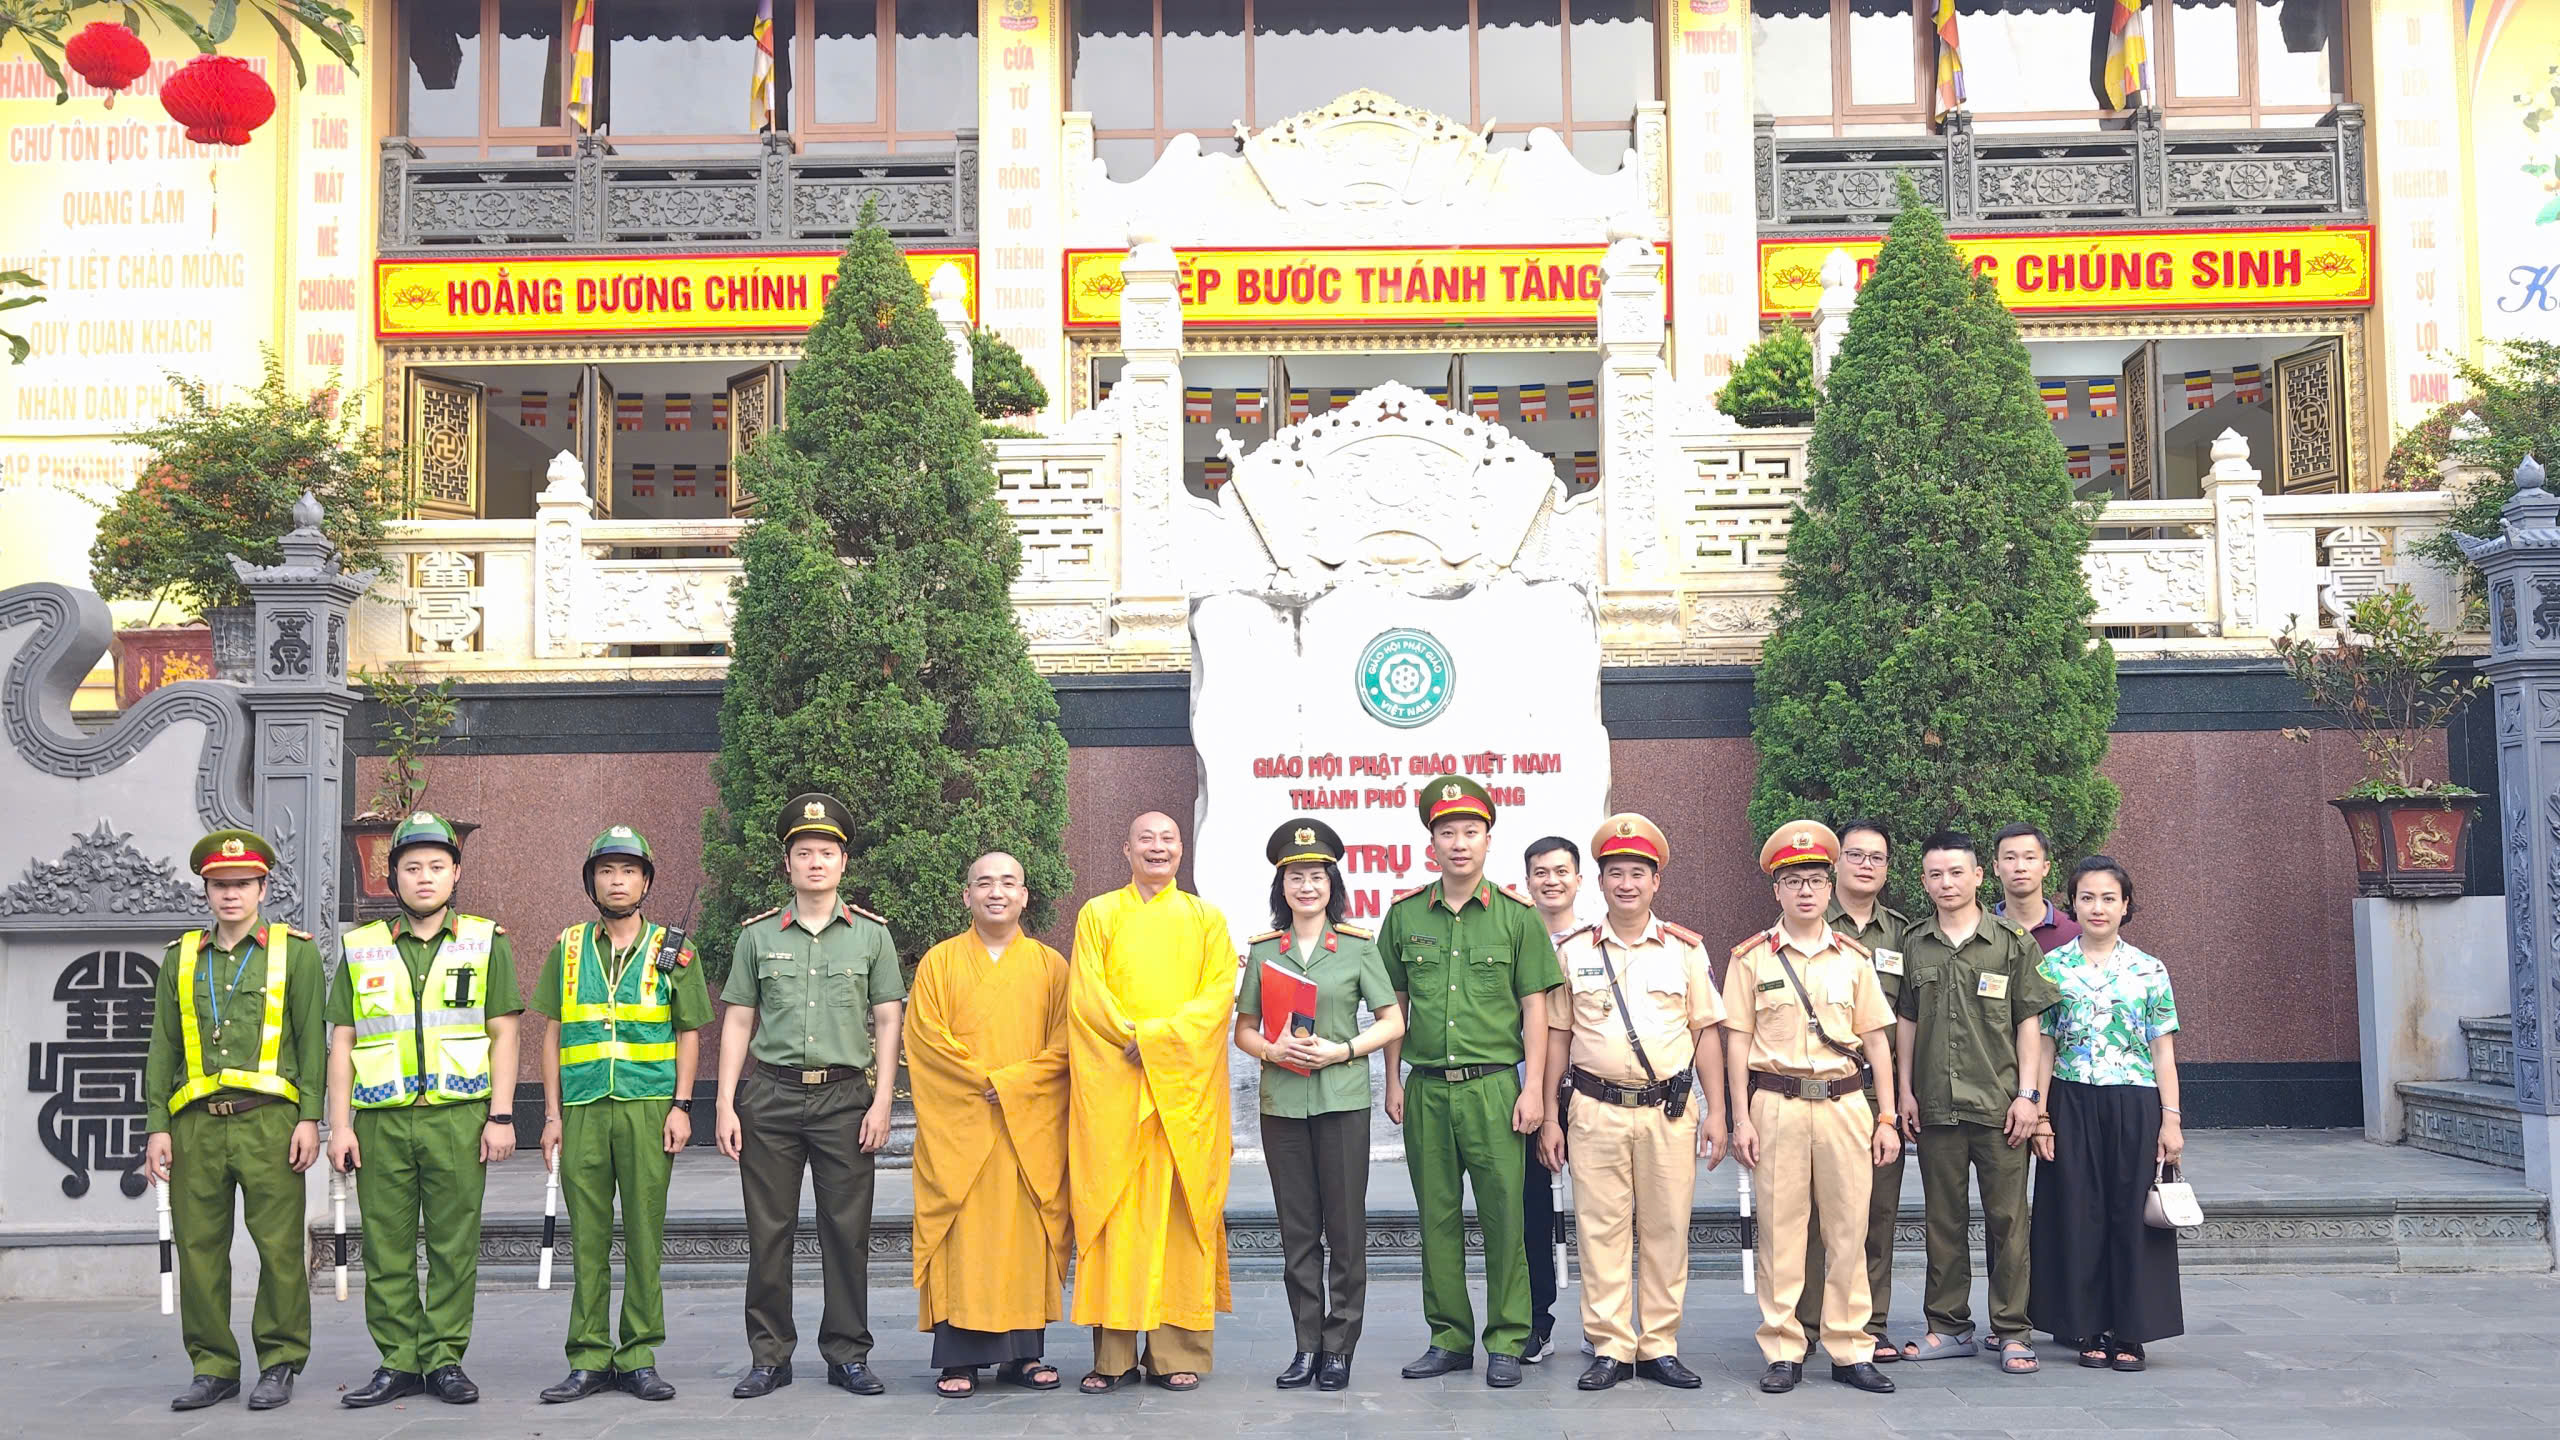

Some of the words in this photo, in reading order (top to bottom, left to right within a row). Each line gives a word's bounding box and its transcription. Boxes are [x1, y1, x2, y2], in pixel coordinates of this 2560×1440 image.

[0, 56, 56, 97] HÀNH
[10, 124, 54, 162] CHƯ
[60, 120, 99, 161] TÔN
[106, 117, 149, 161] ĐỨC
[312, 112, 349, 150] TĂNG
[1011, 127, 1027, 150] BI
[63, 190, 133, 229] QUANG
[140, 182, 185, 225] LÂM
[68, 248, 110, 298] LIỆT
[118, 248, 173, 289] CHÀO
[181, 246, 245, 289] MỪNG
[1177, 256, 1222, 306] ẾP
[1237, 257, 1343, 306] BƯỚC
[1355, 258, 1487, 304] THÁNH
[1500, 257, 1602, 302] TĂNG
[2015, 244, 2174, 293] CHÚNG
[2190, 248, 2302, 289] SINH
[298, 272, 356, 311] CHUÔNG
[446, 266, 564, 316] HOẰNG
[576, 271, 693, 314] DƯƠNG
[704, 266, 808, 313] CHÍNH
[994, 287, 1046, 310] THANG
[78, 320, 134, 357] QUAN
[142, 312, 213, 353] KHÁCH
[2408, 372, 2450, 404] DANH
[1367, 651, 1385, 675] GIÁO
[1424, 650, 1443, 674] GIÁO
[1380, 699, 1405, 717] VIỆT
[1406, 698, 1433, 717] NAM
[1253, 753, 1304, 778] GIÁO
[1308, 752, 1343, 780] HỘI
[1349, 753, 1403, 780] PHẬT
[1408, 752, 1458, 776] GIÁO
[1463, 750, 1508, 778] VIỆT
[1512, 753, 1562, 774] NAM
[1289, 785, 1359, 810] THÀNH
[1364, 782, 1409, 810] PHỐ
[1344, 844, 1412, 879] TRỤ
[1424, 844, 1444, 873] S
